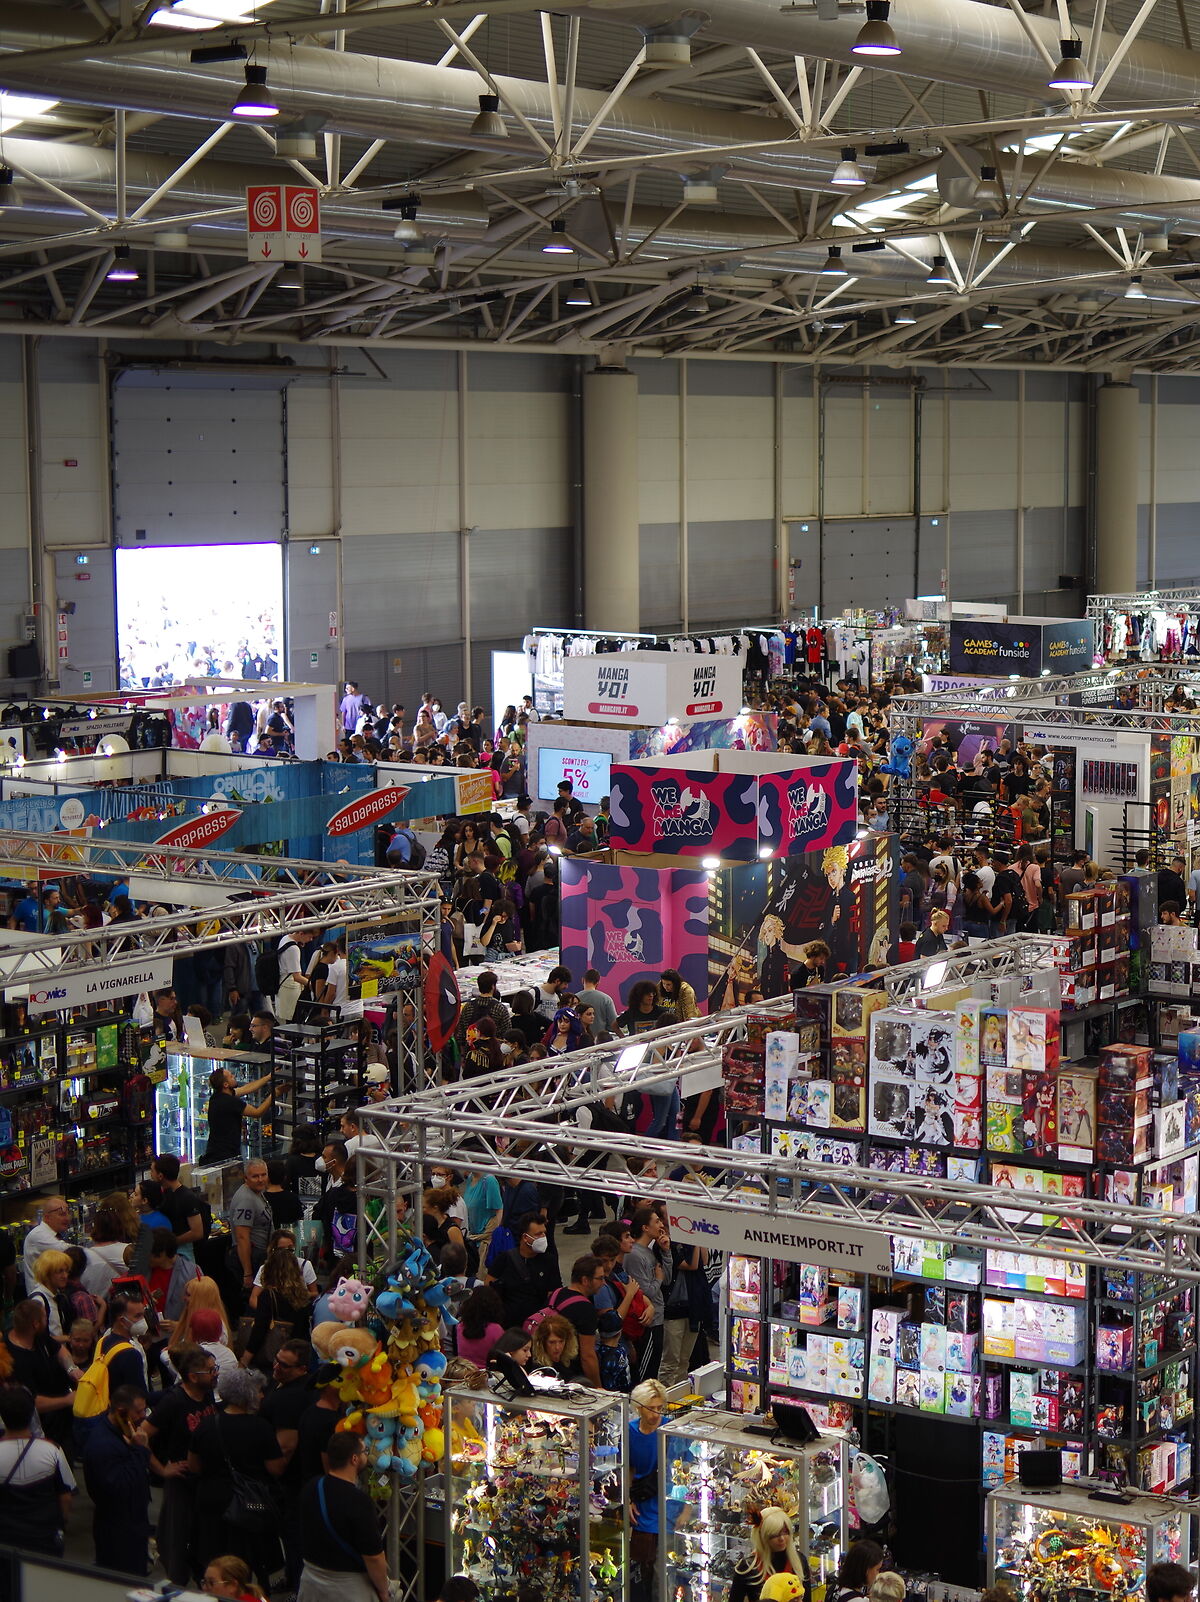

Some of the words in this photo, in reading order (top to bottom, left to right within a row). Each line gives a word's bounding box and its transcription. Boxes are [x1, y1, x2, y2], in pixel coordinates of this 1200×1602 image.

[963, 638, 993, 648] GAMES
[1049, 641, 1067, 650] GAMES
[964, 647, 999, 656] ACADEMY
[999, 645, 1030, 658] funside
[1049, 648, 1070, 658] ACADEMY
[1069, 644, 1087, 656] funside
[598, 667, 629, 682] MANGA
[693, 665, 716, 681] MANGA
[598, 681, 628, 699] YO!
[693, 680, 715, 697] YO!
[1081, 696, 1097, 705] FUNSIDE
[599, 704, 628, 715] MANGAYO.IT
[86, 723, 100, 731] SPAZIO
[102, 721, 125, 730] MILITARE
[213, 769, 276, 793] OBLIVION
[563, 768, 589, 789] 5%
[650, 787, 677, 806] WE
[788, 787, 805, 806] WE
[652, 803, 683, 820] ARE
[788, 803, 808, 819] ARE
[653, 818, 714, 837] MANGA
[788, 815, 828, 838] MANGA
[606, 931, 622, 942] WE
[607, 941, 626, 951] ARE
[607, 950, 646, 962] MANGA
[86, 983, 97, 993] LA
[100, 971, 154, 990] VIGNARELLA
[33, 1139, 55, 1150] WANTED
[236, 1208, 252, 1221] 76
[744, 1229, 864, 1257] ANIMEIMPORT.IT
[876, 1264, 890, 1272] C06
